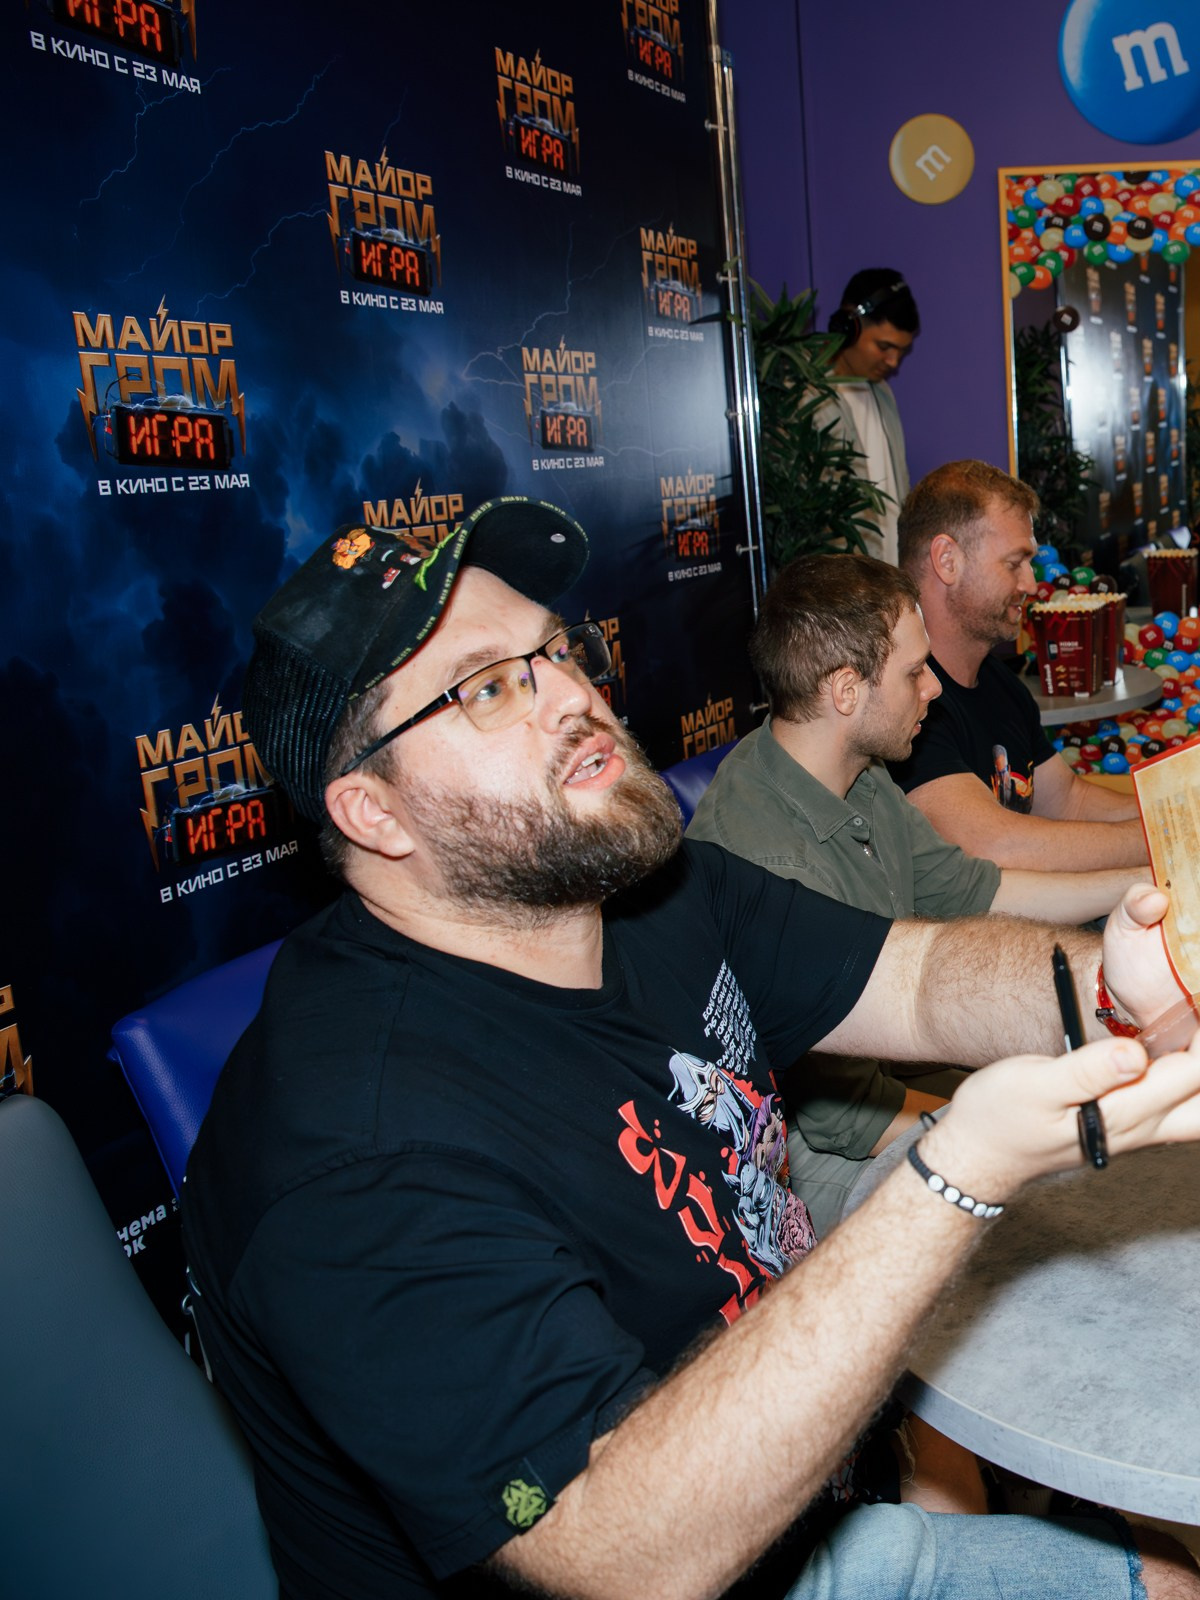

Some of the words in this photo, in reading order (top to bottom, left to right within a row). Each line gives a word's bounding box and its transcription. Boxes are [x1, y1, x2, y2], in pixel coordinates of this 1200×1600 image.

[30, 31, 46, 51] В
[51, 37, 110, 69] КИНО
[114, 56, 128, 75] С
[132, 61, 157, 82] 23
[162, 69, 201, 95] МАЯ
[495, 47, 574, 97] МАЙОР
[1112, 21, 1190, 92] m
[496, 75, 579, 158] ГРОМ
[520, 125, 564, 170] ИГРА
[915, 144, 952, 182] m
[324, 145, 433, 200] МАЙОР
[505, 165, 513, 178] В
[514, 168, 540, 186] КИНО
[541, 176, 549, 188] С
[550, 179, 561, 191] 23
[563, 182, 582, 196] МАЯ
[326, 183, 442, 270] ГРОМ
[360, 240, 420, 286] ИГРА
[72, 294, 233, 355] МАЙОР
[340, 290, 349, 304] В
[352, 291, 387, 308] КИНО
[390, 296, 399, 309] С
[401, 297, 416, 311] 23
[419, 300, 444, 314] МАЯ
[521, 334, 596, 374] МАЙОР
[76, 351, 246, 438] ГРОМ
[128, 414, 215, 460] ИГРА
[545, 415, 587, 447] ИГРА
[98, 480, 111, 496] В
[116, 477, 168, 495] КИНО
[172, 477, 184, 492] С
[188, 476, 210, 491] 23
[214, 474, 250, 489] МАЯ
[532, 459, 539, 471] В
[541, 458, 565, 470] КИНО
[566, 458, 572, 469] С
[574, 457, 585, 468] 23
[586, 456, 604, 467] МАЯ
[363, 477, 464, 527] МАЙОР
[135, 692, 250, 768] МАЙО
[681, 692, 733, 736] МАЙОР
[186, 800, 266, 855] ИГРА
[160, 886, 173, 903] В
[176, 867, 224, 897] КИНО
[226, 862, 239, 878] С
[242, 853, 263, 872] 23
[266, 840, 298, 864] МАЯ
[116, 1204, 167, 1241] нема
